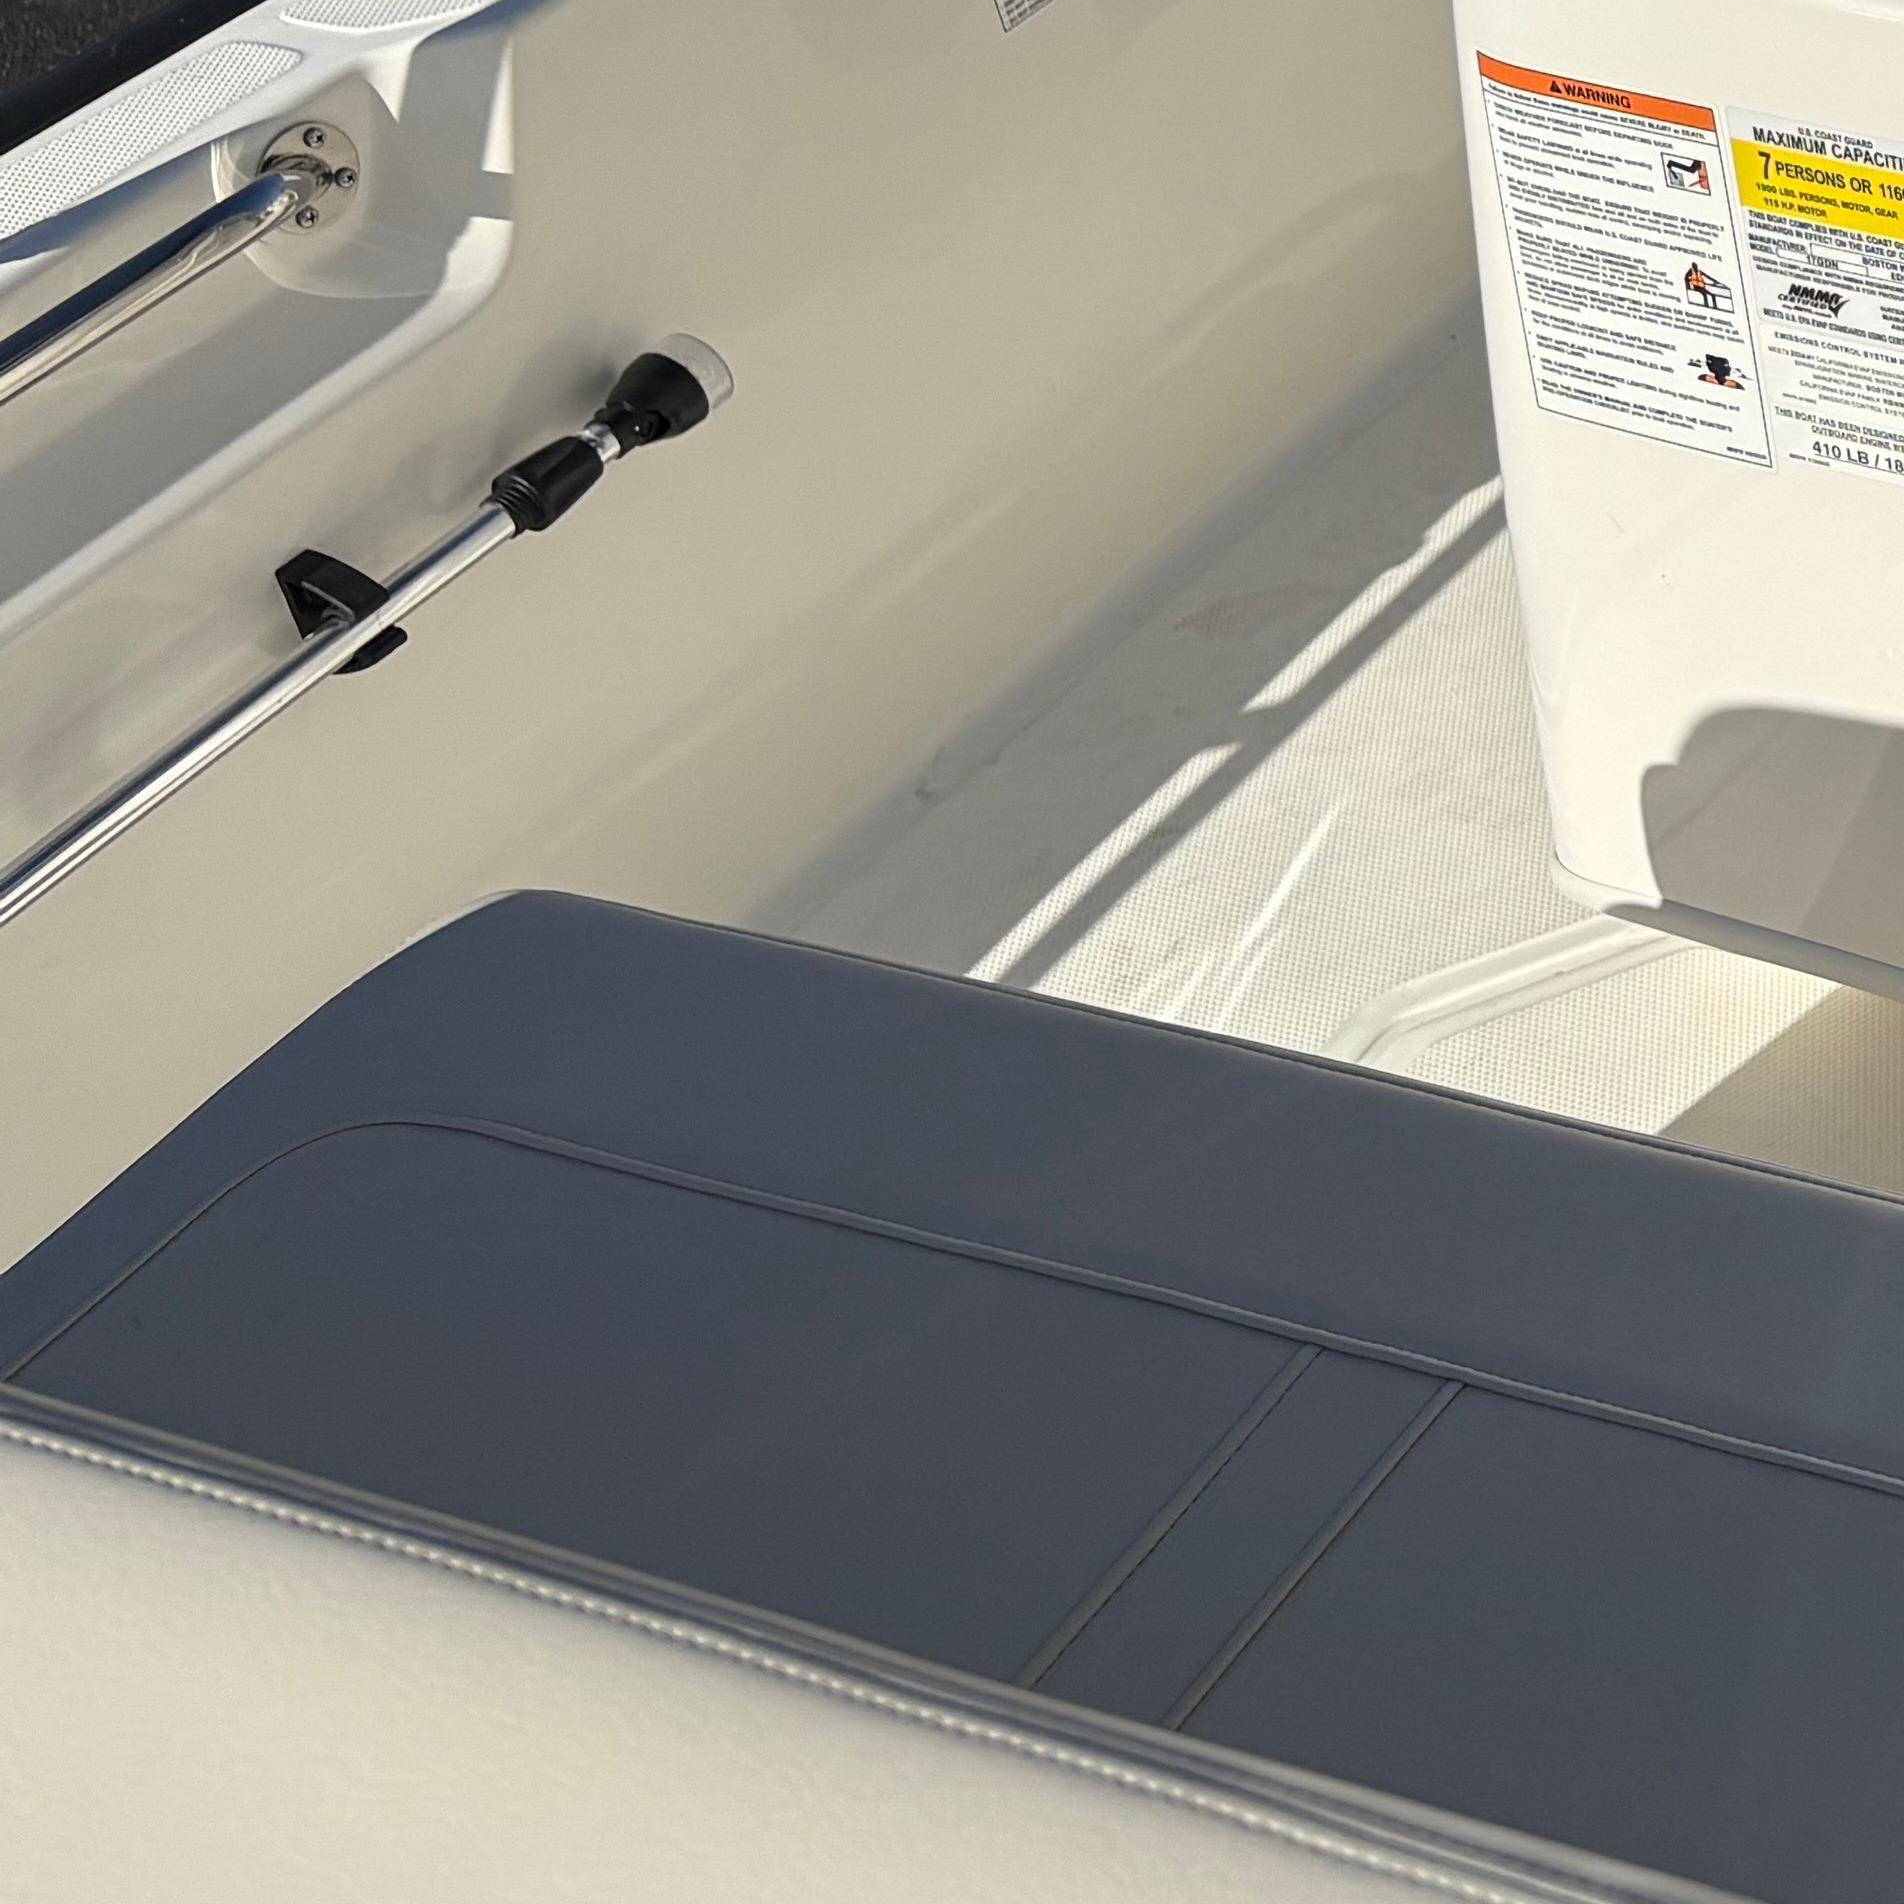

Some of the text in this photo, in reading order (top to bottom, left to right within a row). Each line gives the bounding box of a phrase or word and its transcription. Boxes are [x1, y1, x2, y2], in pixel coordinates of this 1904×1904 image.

[1562, 81, 1632, 109] WARNING
[1752, 126, 1826, 155] MAXIMUM
[1758, 151, 1772, 180] 7
[1774, 160, 1846, 189] PERSONS
[1849, 176, 1872, 195] OR
[1812, 440, 1841, 459] 410
[1846, 447, 1869, 465] LB
